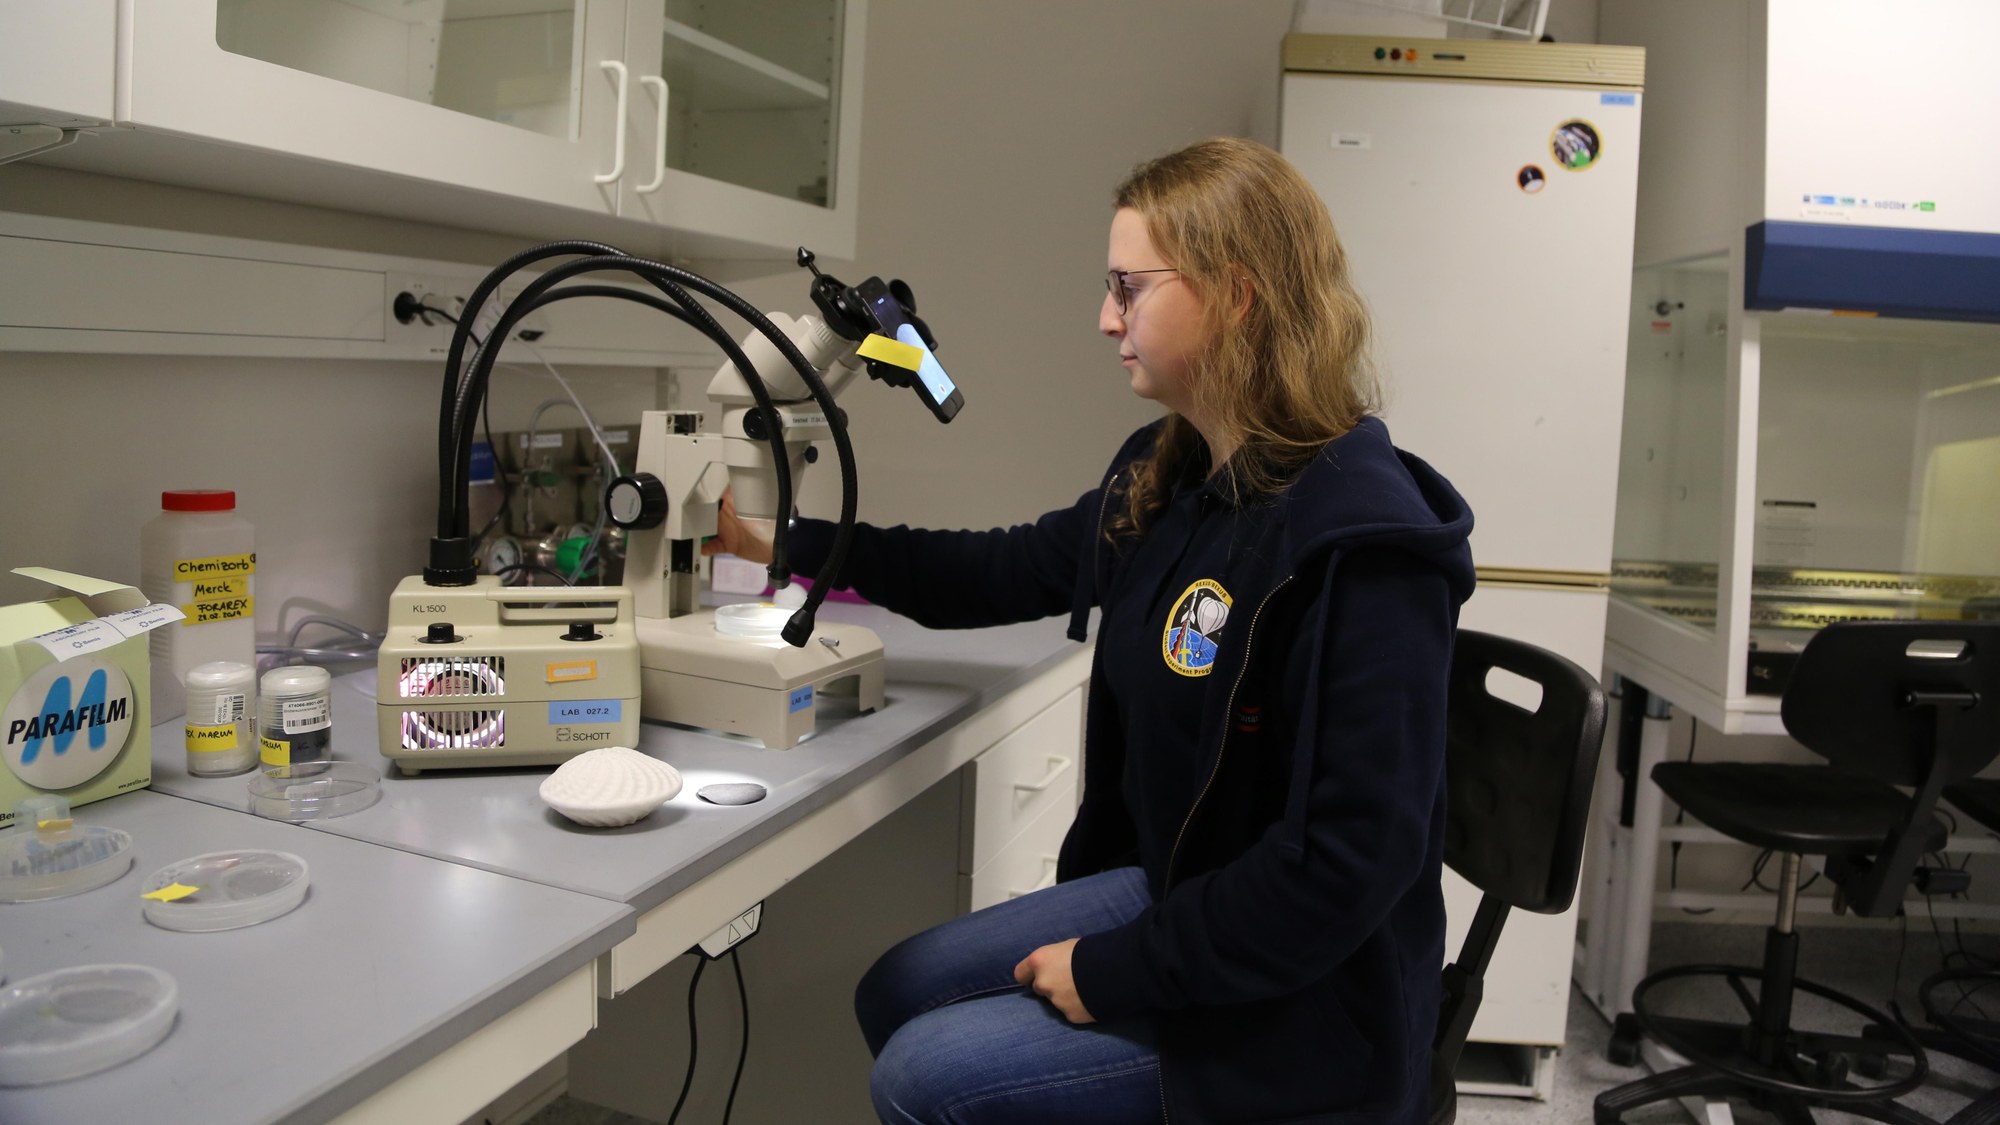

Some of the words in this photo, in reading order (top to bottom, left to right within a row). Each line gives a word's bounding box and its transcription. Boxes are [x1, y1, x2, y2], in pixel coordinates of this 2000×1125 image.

[195, 581, 232, 597] Merck
[197, 598, 247, 613] FORAREX
[8, 697, 127, 745] PARAFILM
[198, 729, 233, 739] MARUM
[572, 732, 611, 741] SCHOTT
